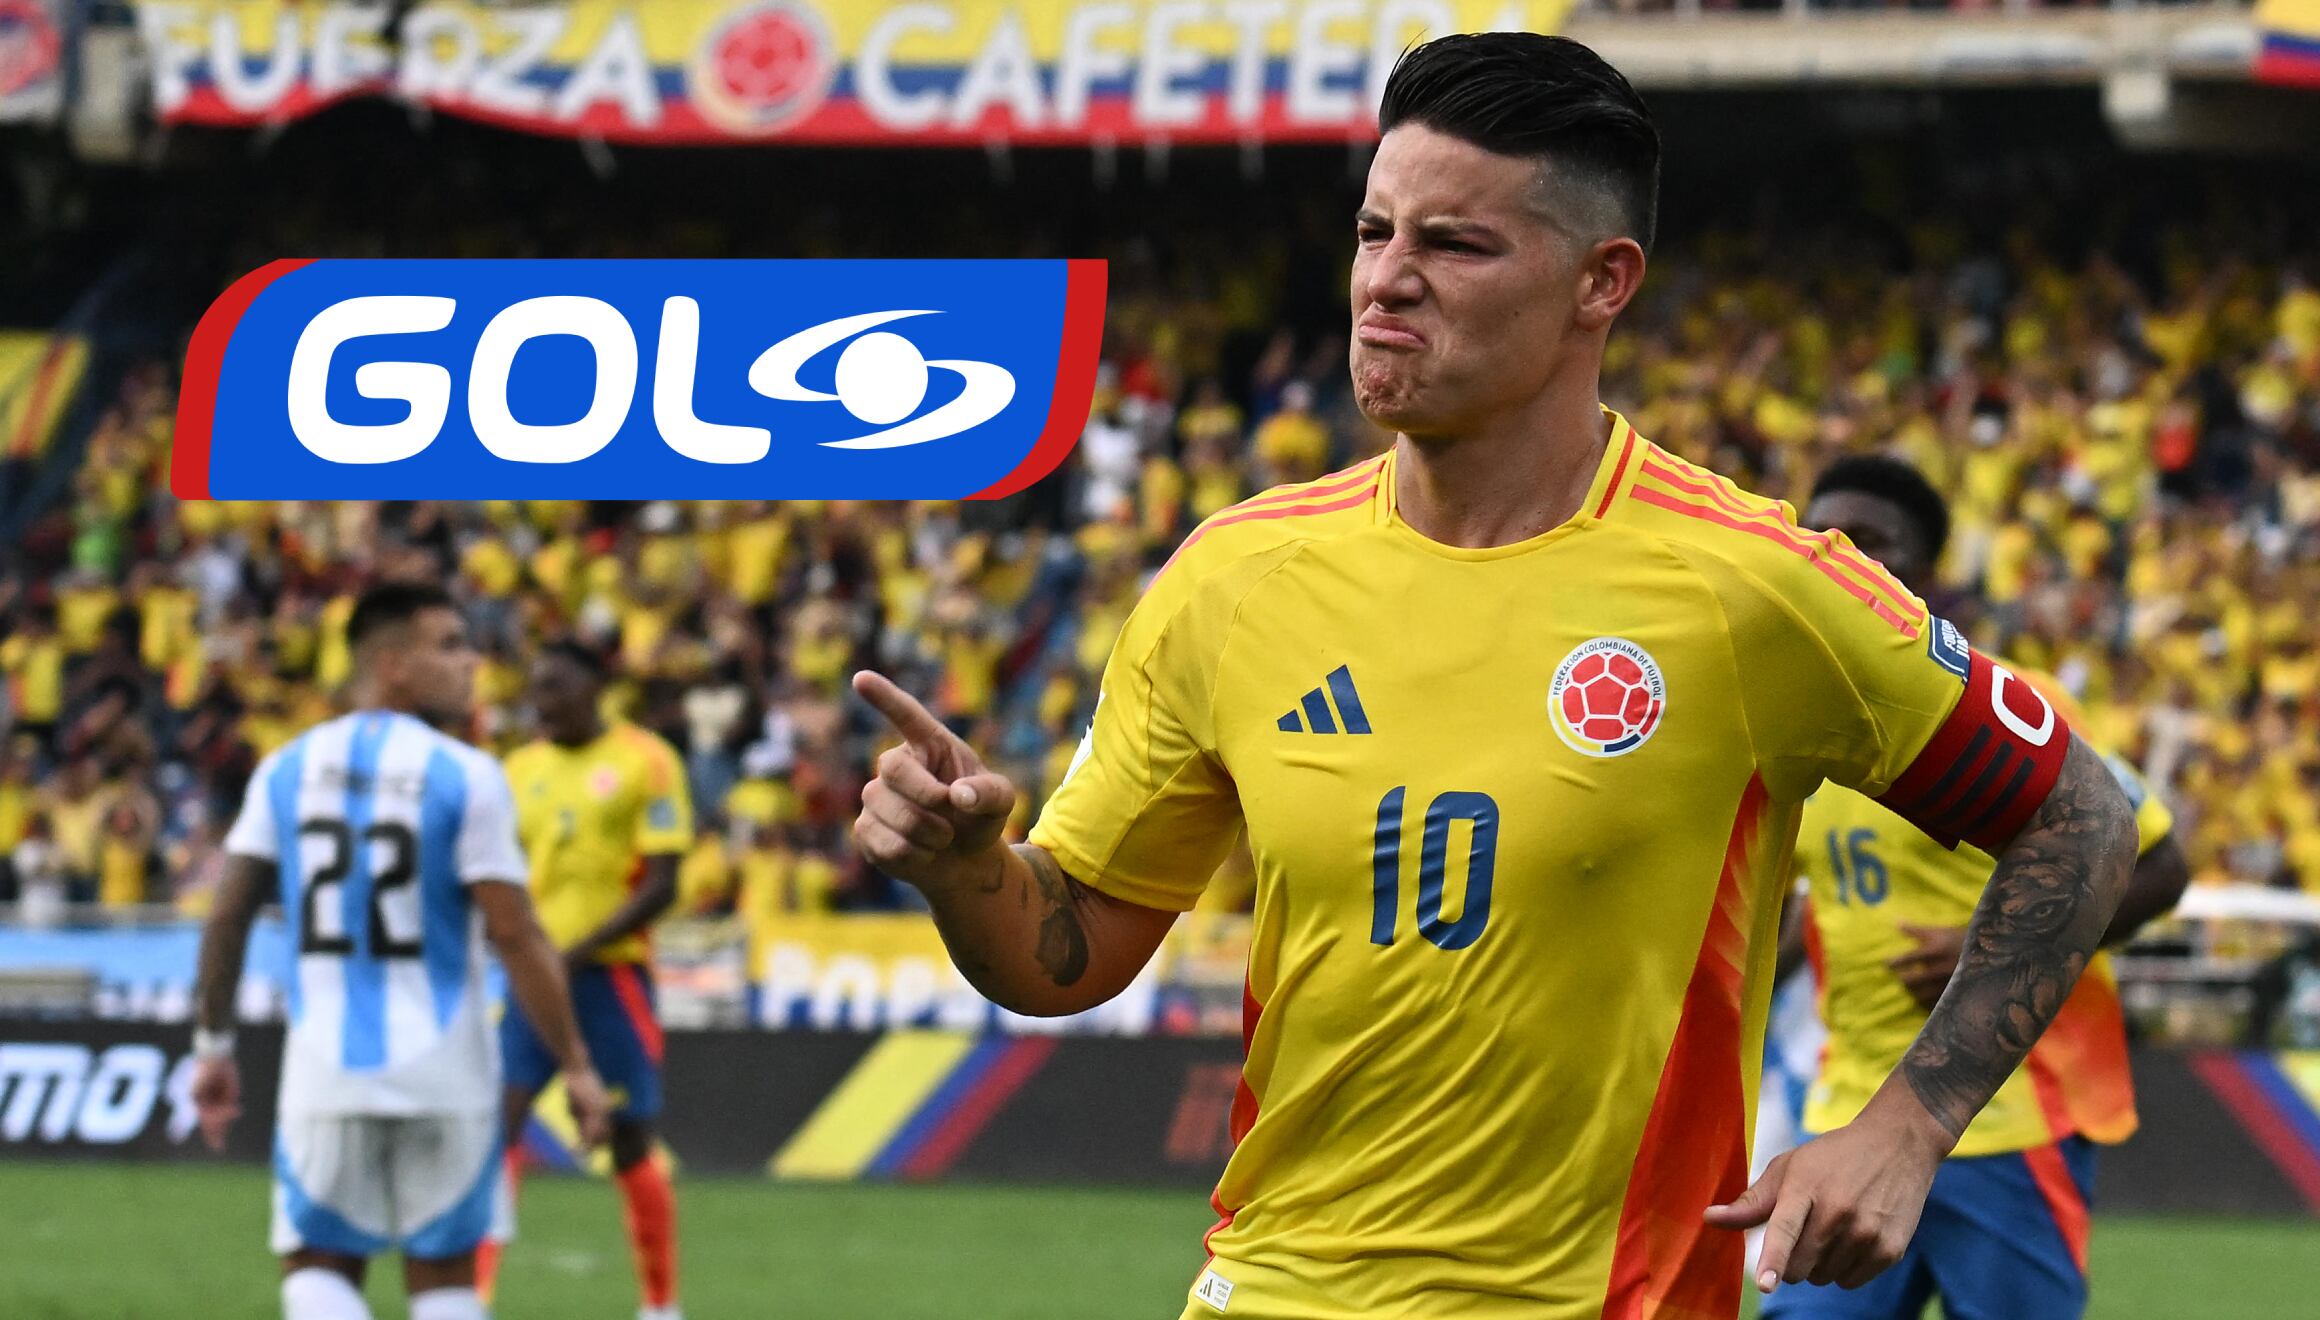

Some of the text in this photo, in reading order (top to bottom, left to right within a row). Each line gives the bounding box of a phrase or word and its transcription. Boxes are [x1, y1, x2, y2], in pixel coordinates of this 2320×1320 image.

[143, 0, 1530, 132] FUERZA CAFETER
[1584, 641, 1638, 659] COLOMBIANA
[1639, 655, 1648, 666] DE
[1991, 664, 2055, 746] C
[298, 817, 424, 958] 22
[1370, 785, 1500, 951] 10
[1826, 826, 1889, 908] 16
